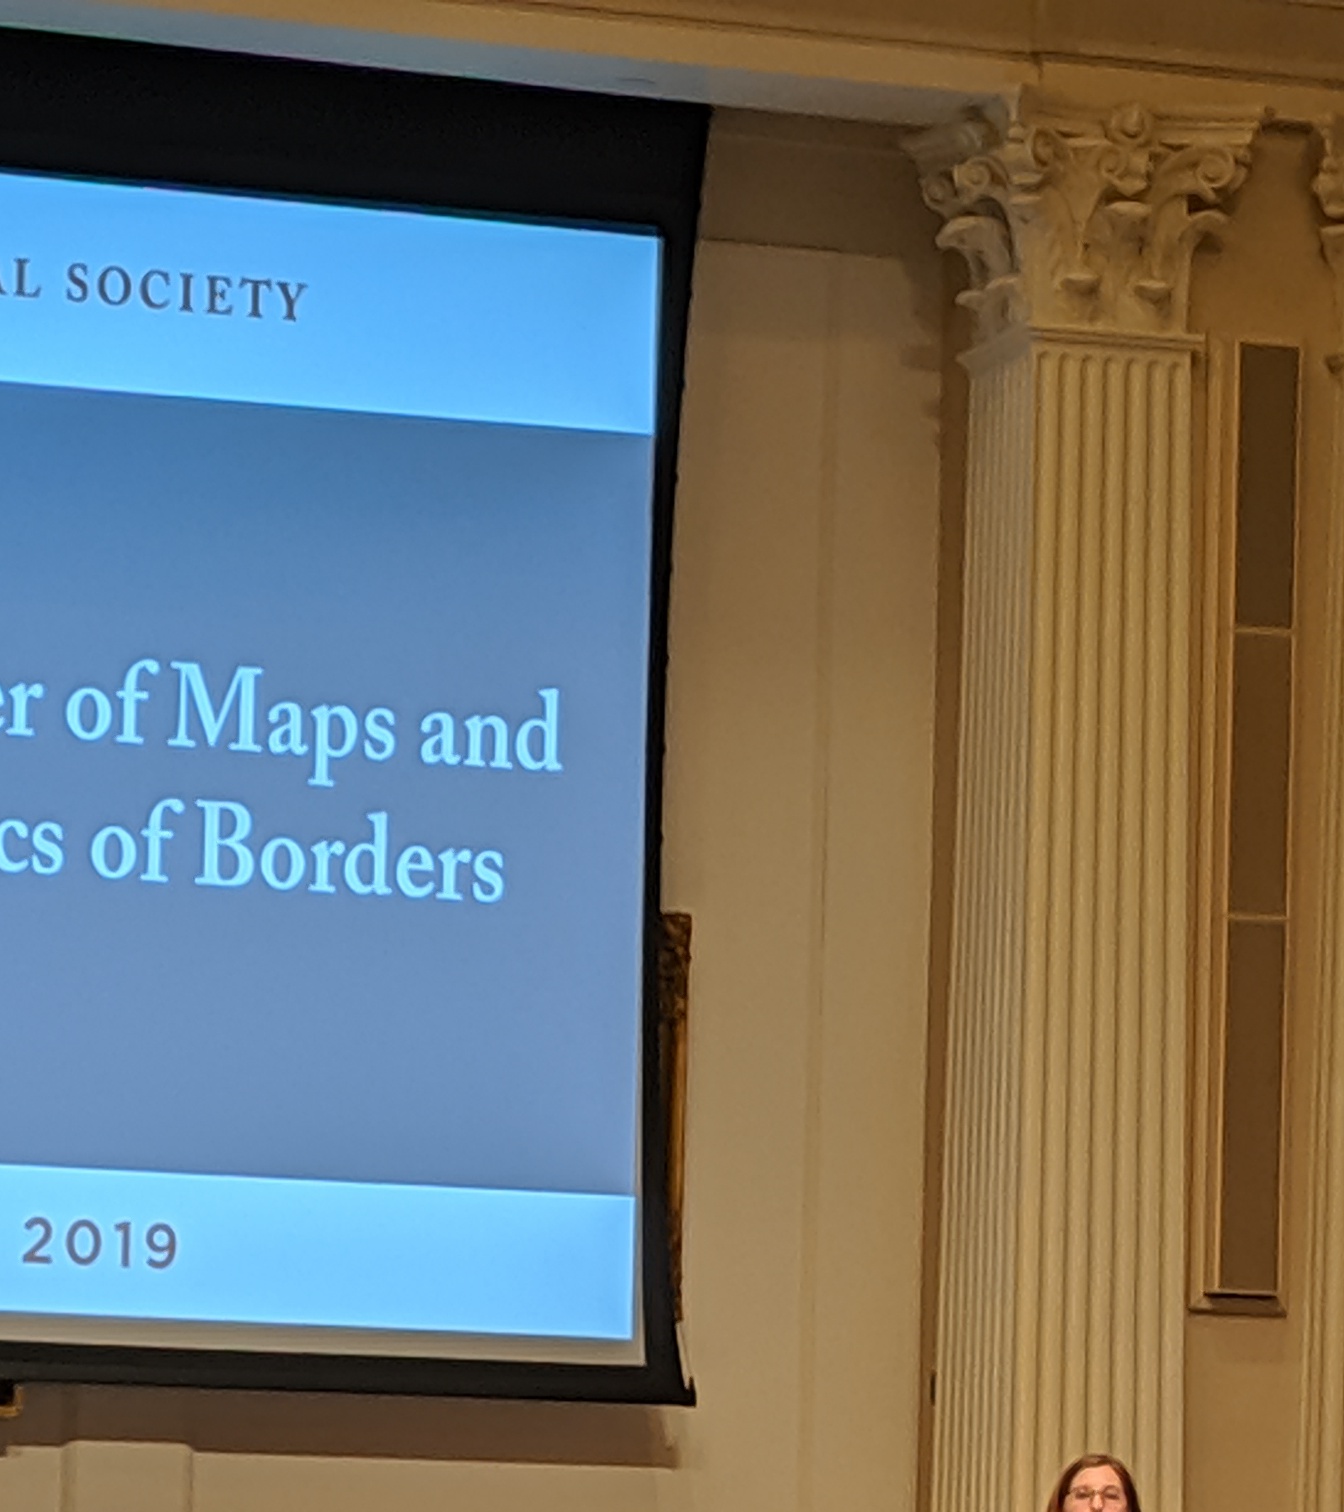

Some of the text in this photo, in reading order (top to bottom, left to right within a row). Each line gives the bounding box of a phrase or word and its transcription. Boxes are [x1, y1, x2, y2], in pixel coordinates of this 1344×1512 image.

[65, 262, 309, 322] SOCIETY
[65, 658, 159, 745] of
[167, 660, 396, 788] Maps
[419, 686, 563, 772] and
[90, 797, 185, 883] of
[194, 798, 504, 904] Borders
[21, 1215, 179, 1271] 2019
